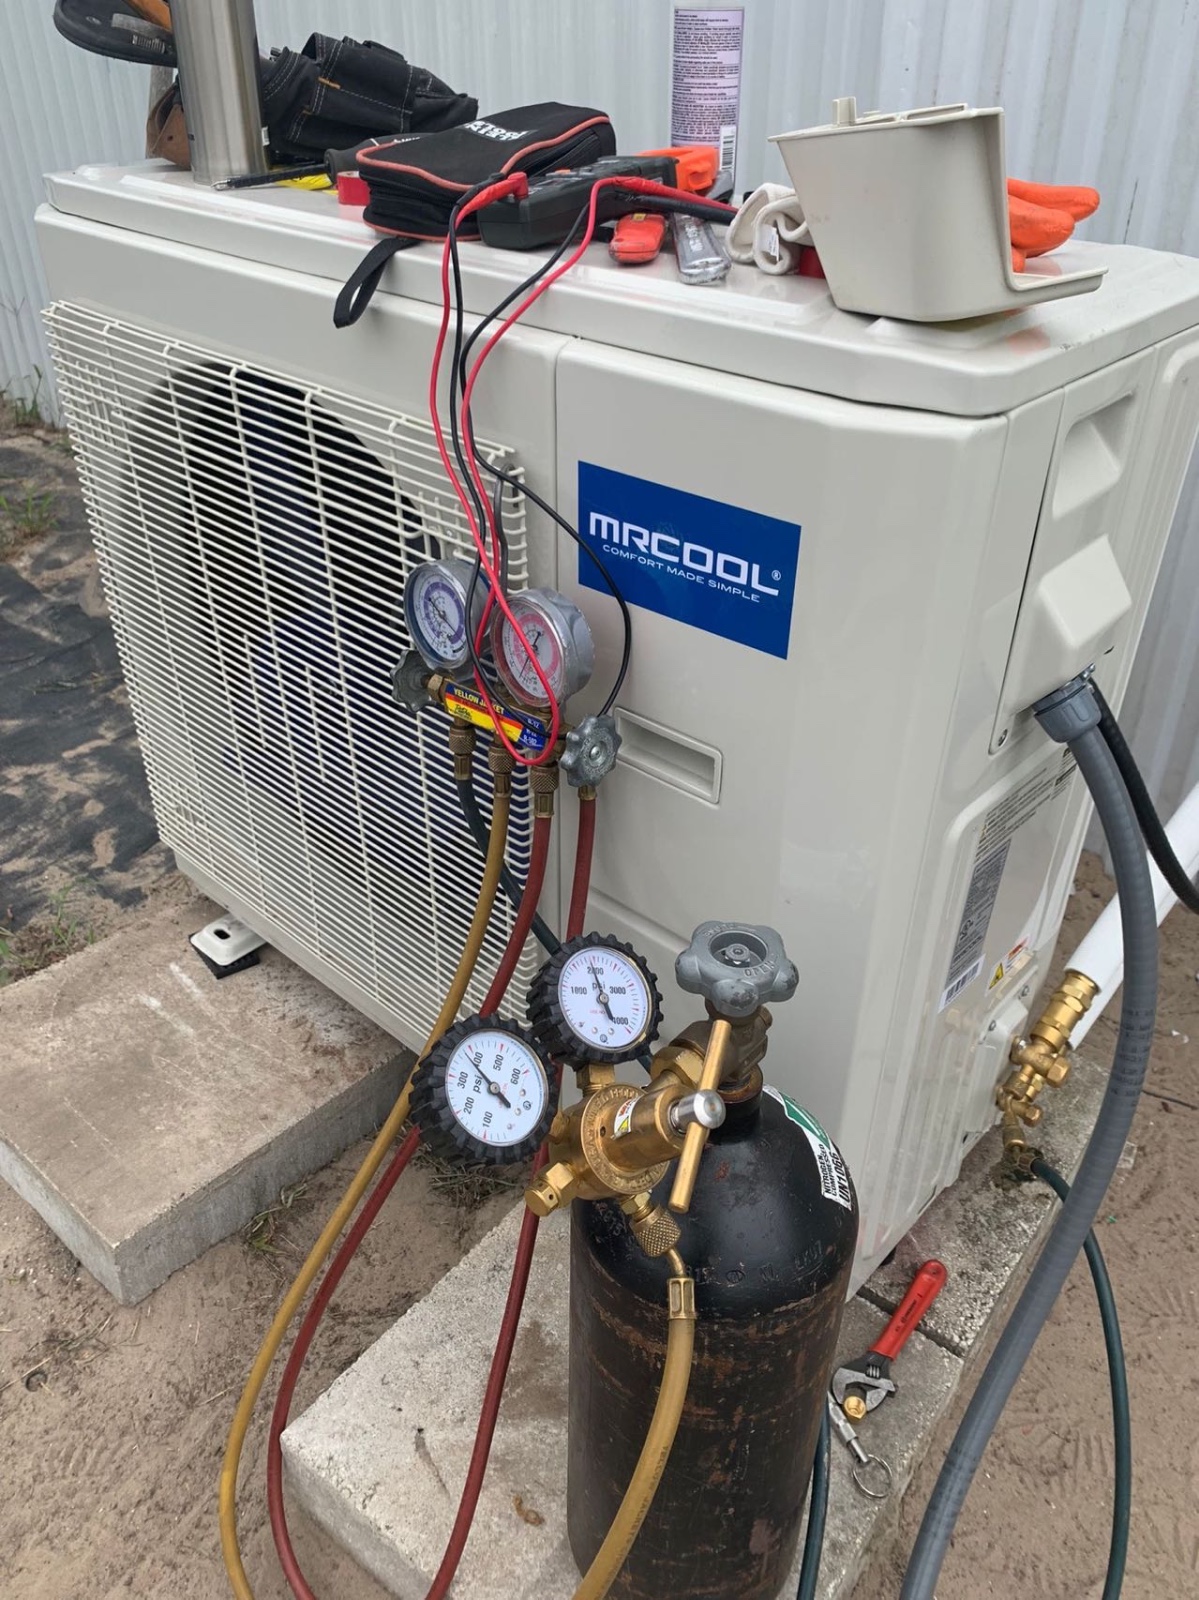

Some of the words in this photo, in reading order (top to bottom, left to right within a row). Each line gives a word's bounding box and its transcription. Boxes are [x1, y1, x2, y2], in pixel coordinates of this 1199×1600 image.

[603, 544, 664, 570] COMFORT
[666, 565, 705, 585] MADE
[708, 579, 760, 603] SIMPLE
[454, 687, 479, 704] YELLOW
[479, 698, 505, 715] JAKET
[571, 986, 587, 995] 1000
[609, 986, 626, 995] 3000
[492, 1054, 504, 1071] 500
[457, 1071, 469, 1089] 300
[473, 1074, 483, 1094] psi
[510, 1068, 521, 1085] 600
[463, 1096, 475, 1115] 200
[482, 1111, 493, 1128] 100
[817, 1154, 832, 1194] NITROGEN
[818, 1143, 838, 1197] COMPRESSED
[829, 1151, 850, 1203] UN1066
